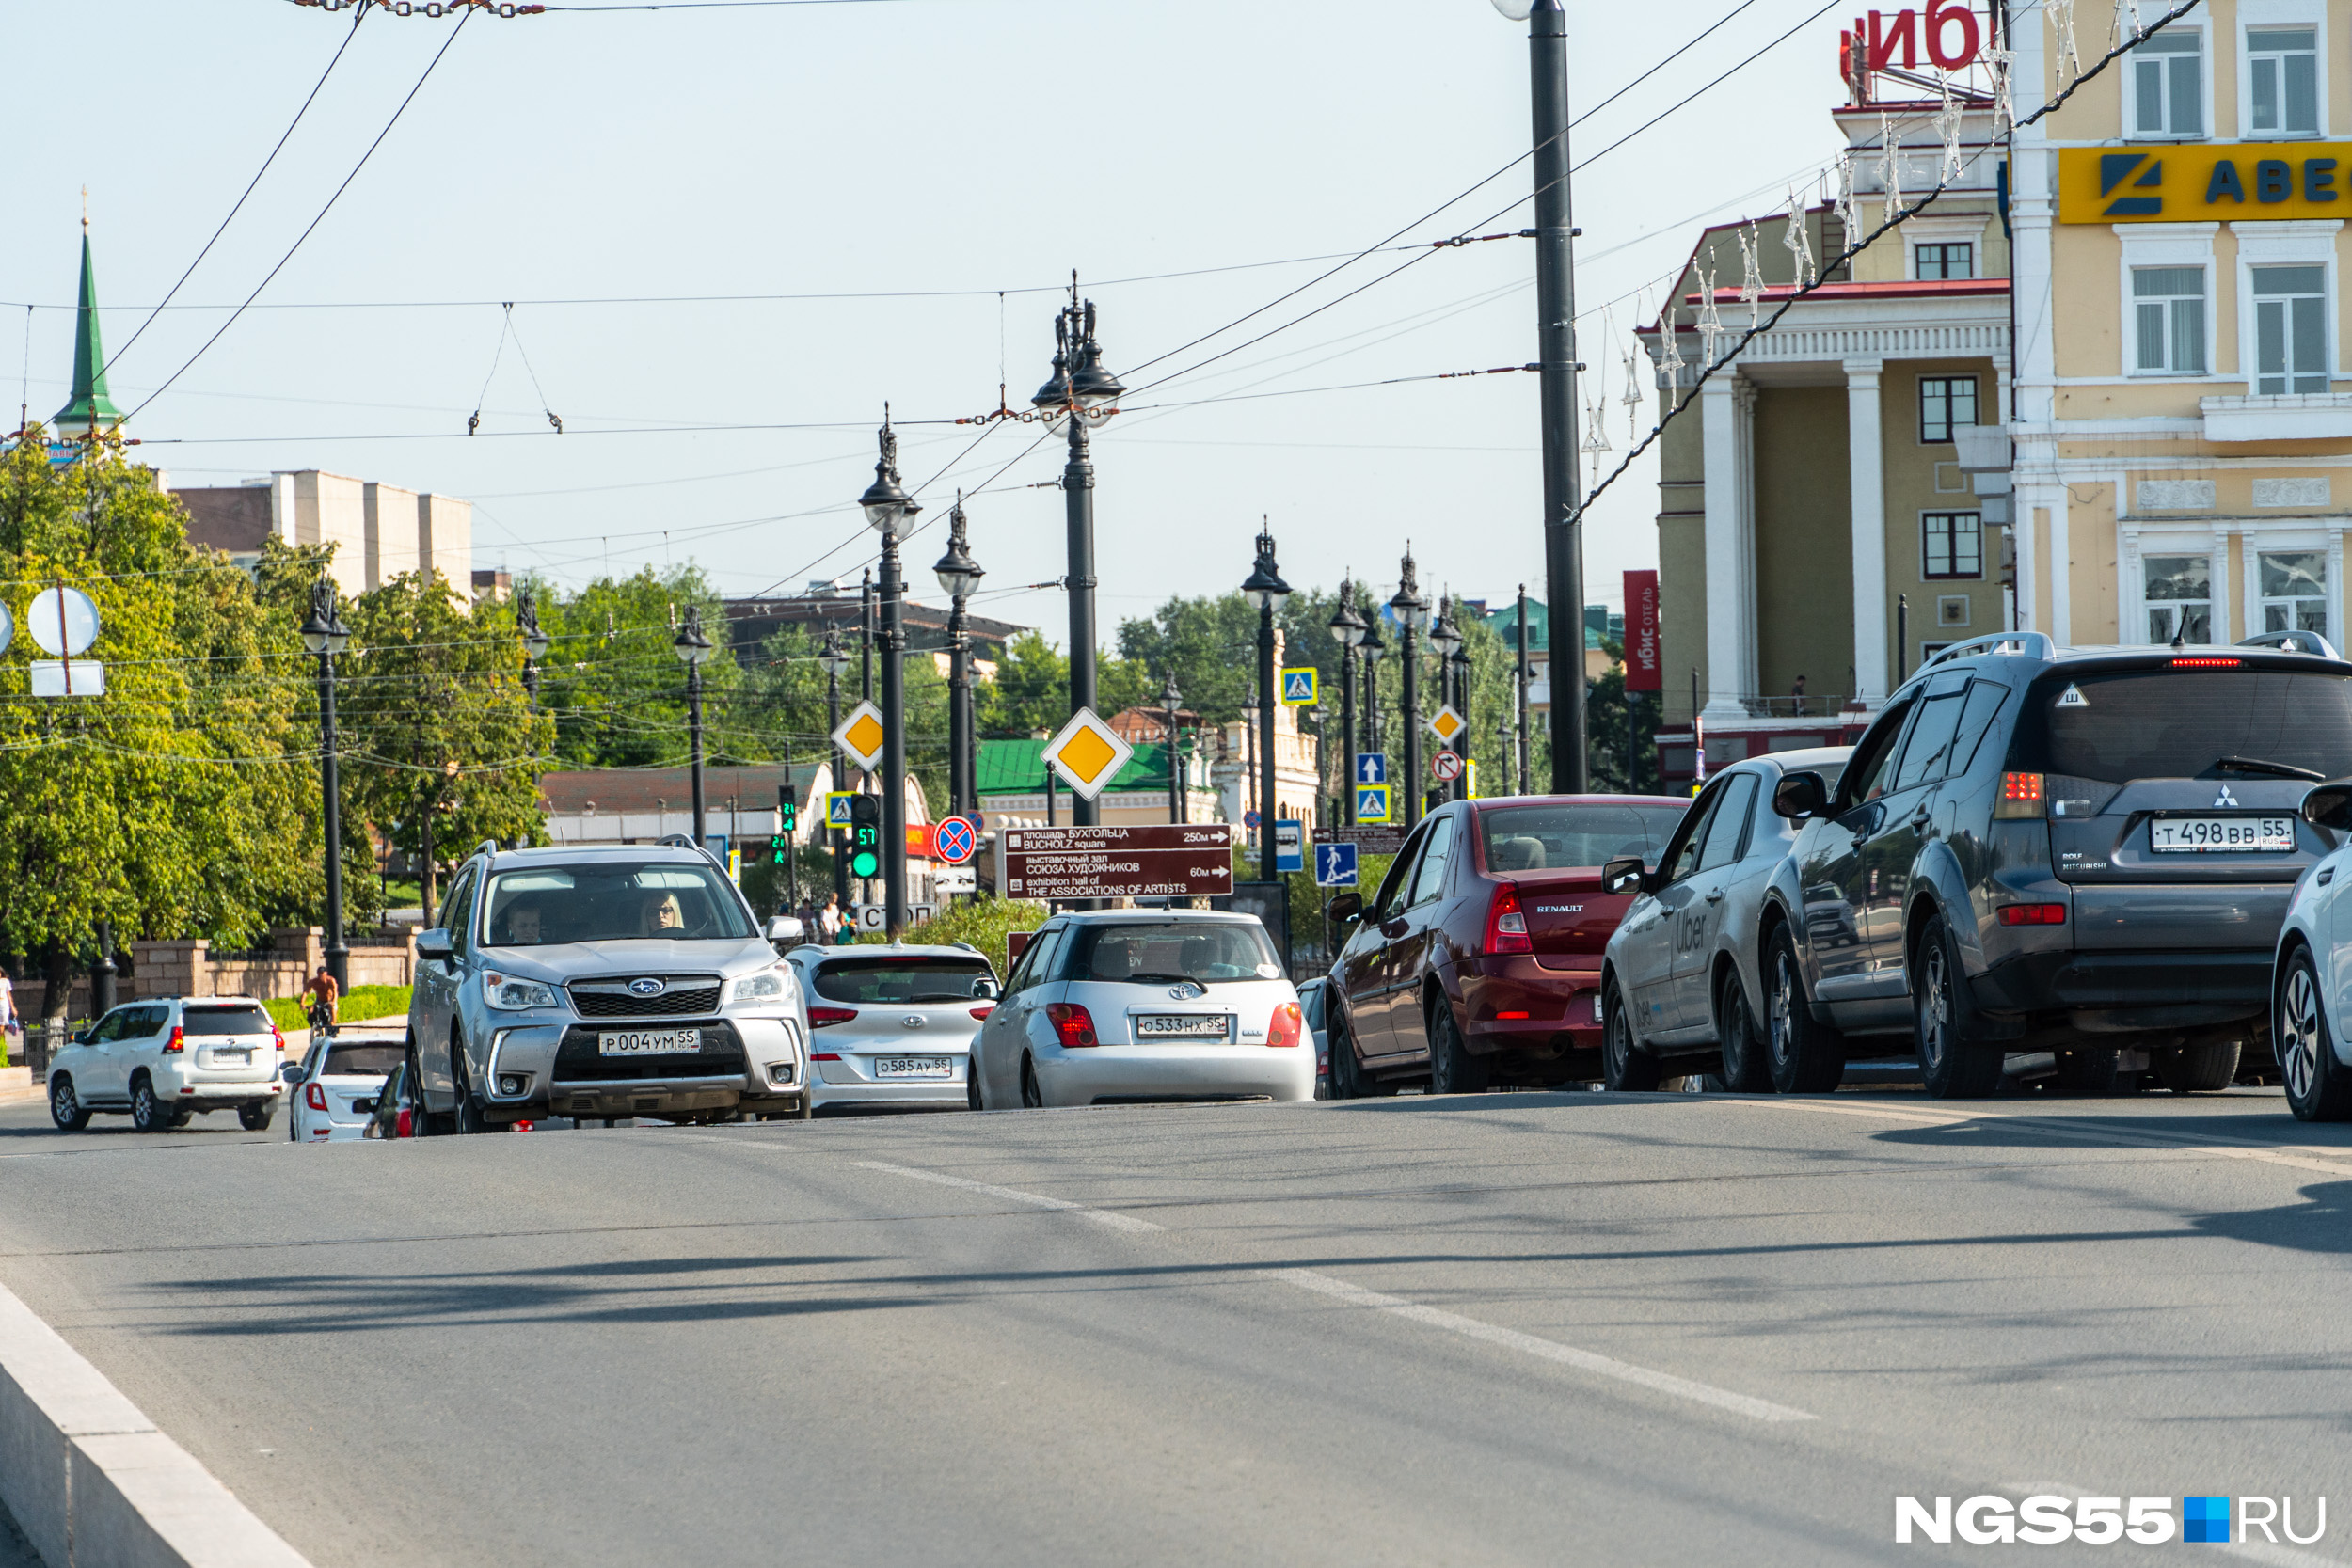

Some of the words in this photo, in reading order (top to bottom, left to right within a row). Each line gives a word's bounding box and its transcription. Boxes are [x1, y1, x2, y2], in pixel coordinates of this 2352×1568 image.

[1868, 0, 1996, 71] иб
[2205, 158, 2352, 204] АВЕ
[1642, 587, 1654, 626] ОТЕЛЬ
[1638, 628, 1655, 670] ибис
[2066, 694, 2078, 703] Ш
[783, 803, 794, 814] 21
[2263, 820, 2285, 837] 55
[858, 828, 875, 846] 57
[1024, 831, 1066, 840] площадь
[1068, 829, 1129, 839] БУХГОЛЬЦА
[1184, 832, 1209, 843] 250м
[772, 836, 785, 847] 21
[1024, 839, 1073, 849] BUCHOLZ
[1074, 840, 1106, 849] square
[1026, 854, 1089, 864] выставочный
[1091, 854, 1108, 863] зал
[1026, 864, 1065, 875] СОЮЗА
[1068, 863, 1140, 874] ХУДОЖНИКОВ
[1190, 867, 1209, 878] 60м
[1026, 877, 1069, 887] exhibition
[1072, 876, 1088, 885] hall
[1089, 876, 1099, 885] of
[1027, 887, 1047, 896] THE
[1049, 885, 1125, 896] ASSOCIATIONS
[1127, 884, 1141, 895] OF
[1144, 883, 1186, 895] ARTISTS
[865, 907, 930, 927] СП
[1677, 908, 1707, 954] Uber
[1206, 1017, 1222, 1028] 55
[678, 1031, 694, 1043] 55
[934, 1059, 947, 1069] 55
